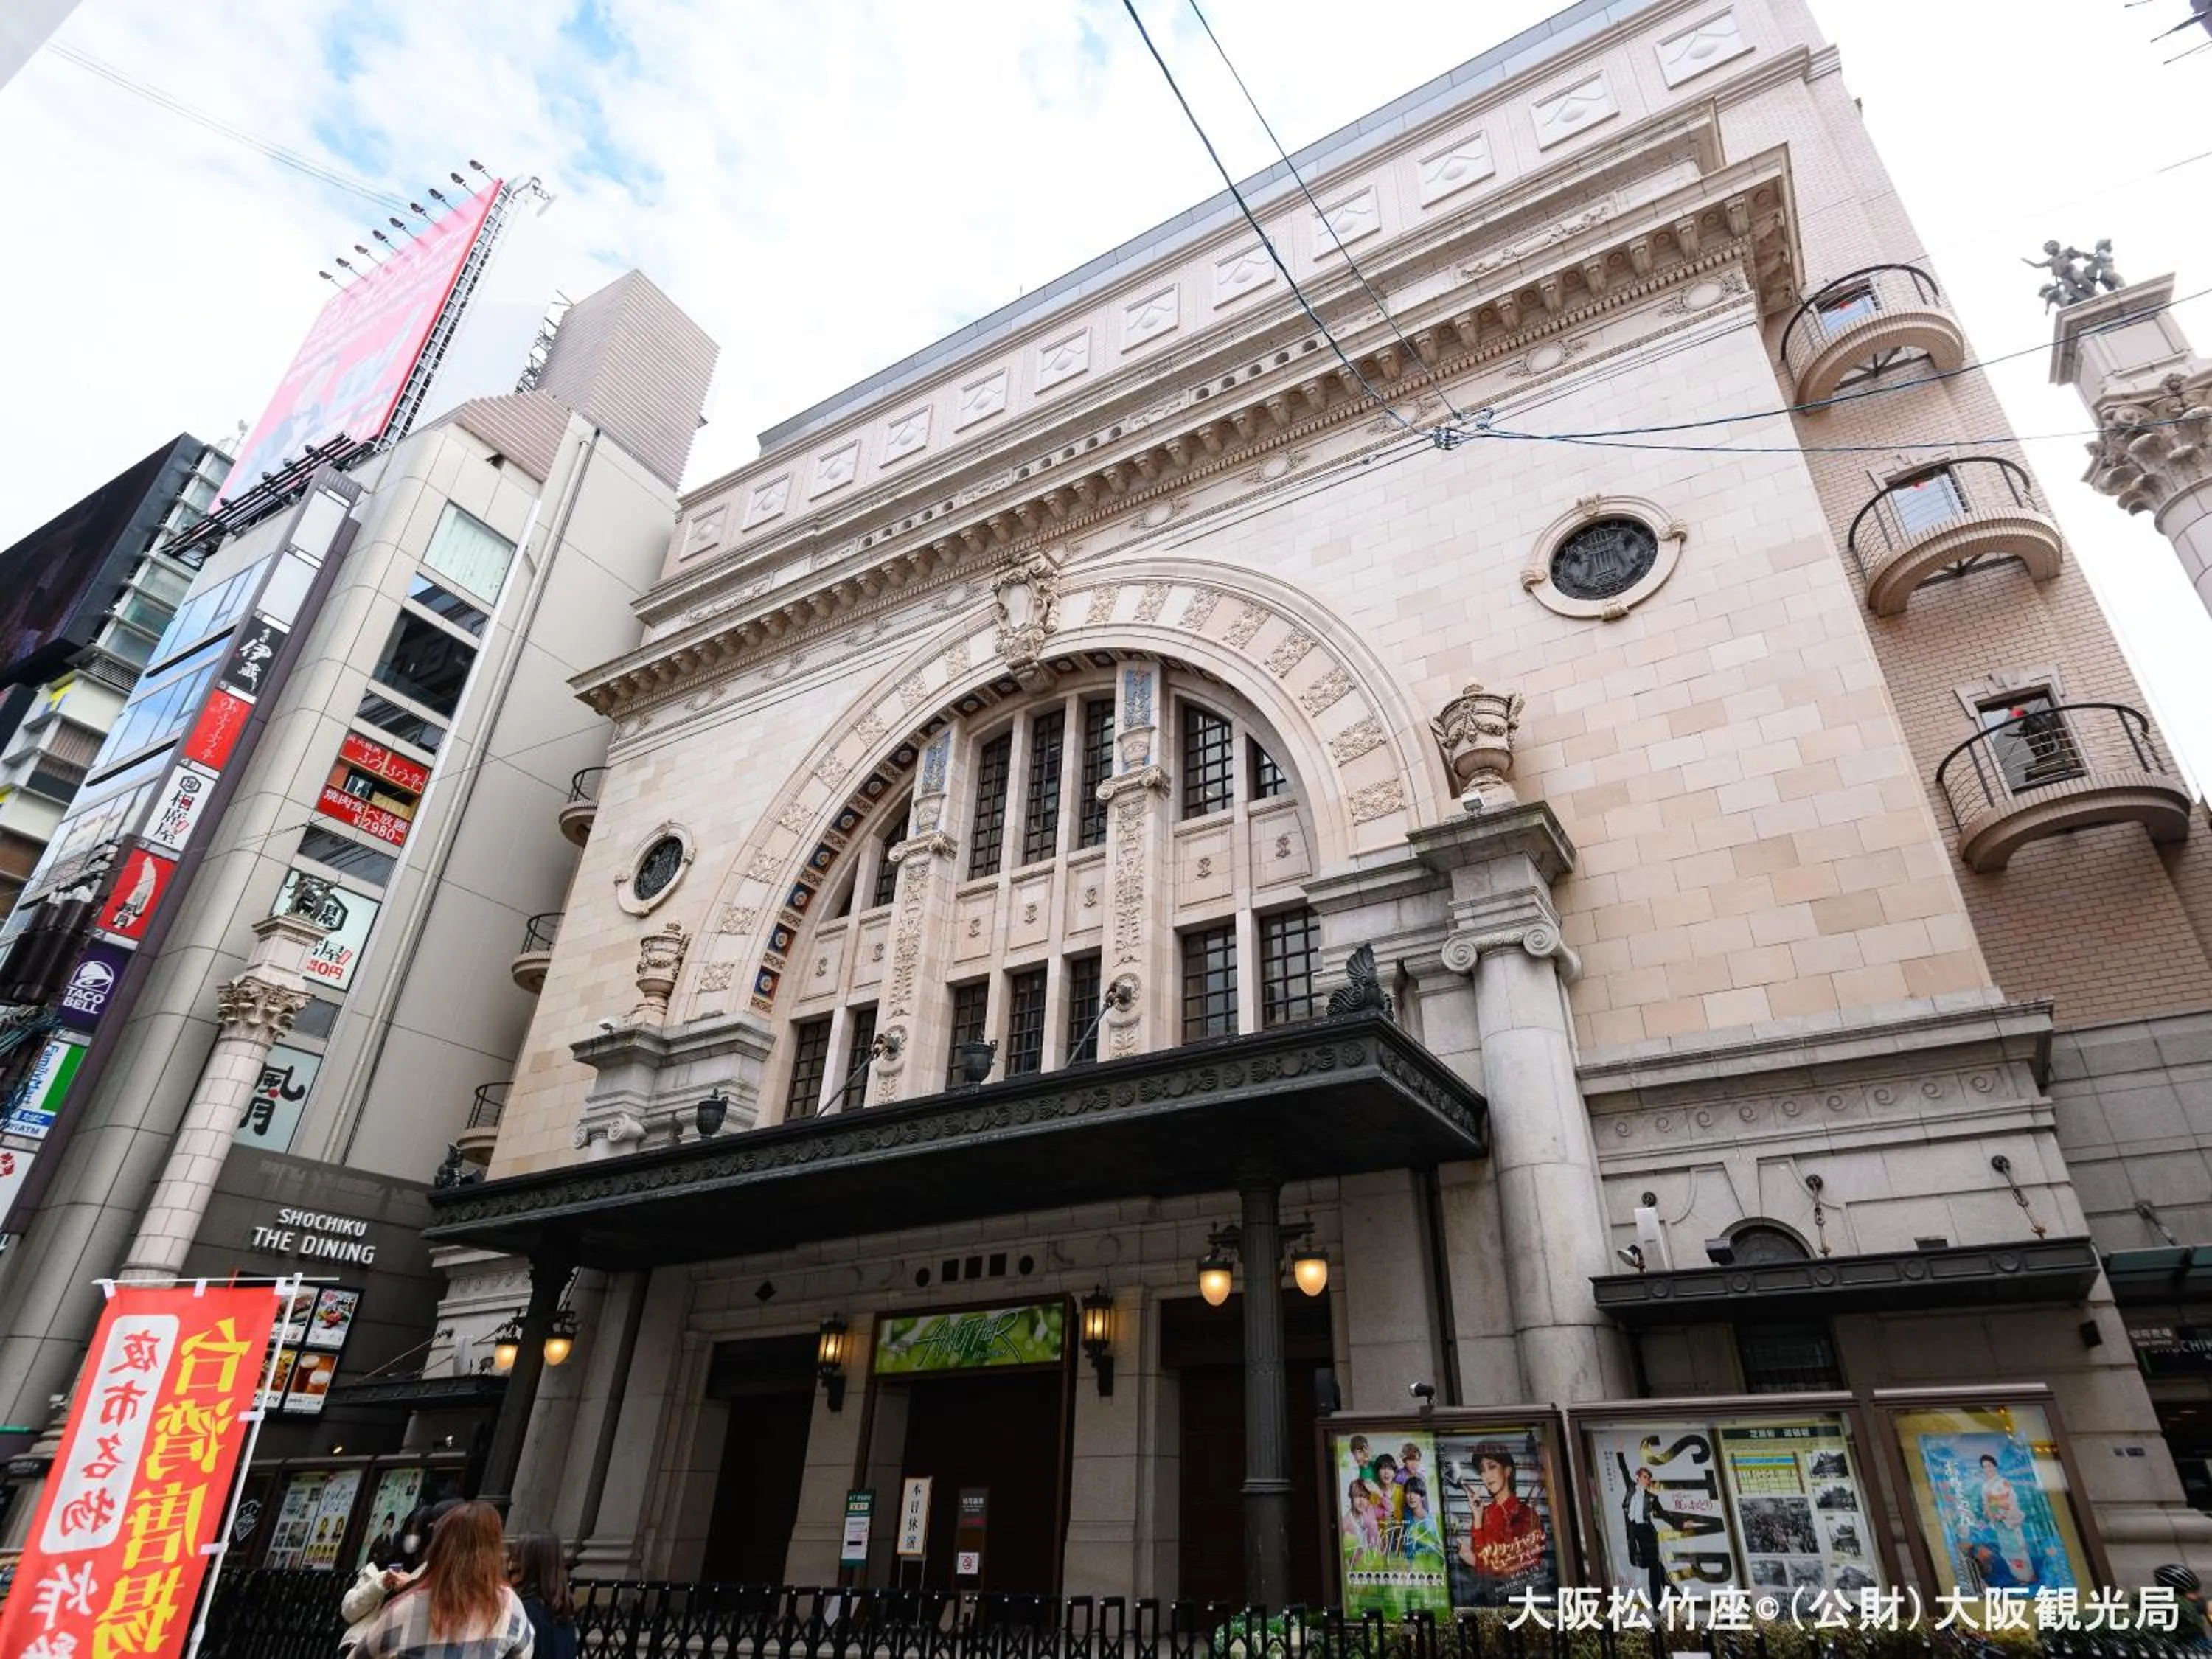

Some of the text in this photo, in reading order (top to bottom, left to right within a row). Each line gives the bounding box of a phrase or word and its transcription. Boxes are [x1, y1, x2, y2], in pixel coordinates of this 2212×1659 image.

[63, 995, 100, 1015] BELL
[66, 985, 105, 1004] TACO
[237, 1060, 306, 1137] 風月
[278, 1208, 367, 1237] SHOCHIKU
[251, 1225, 377, 1265] THE DINING
[1640, 1434, 1733, 1584] STAR
